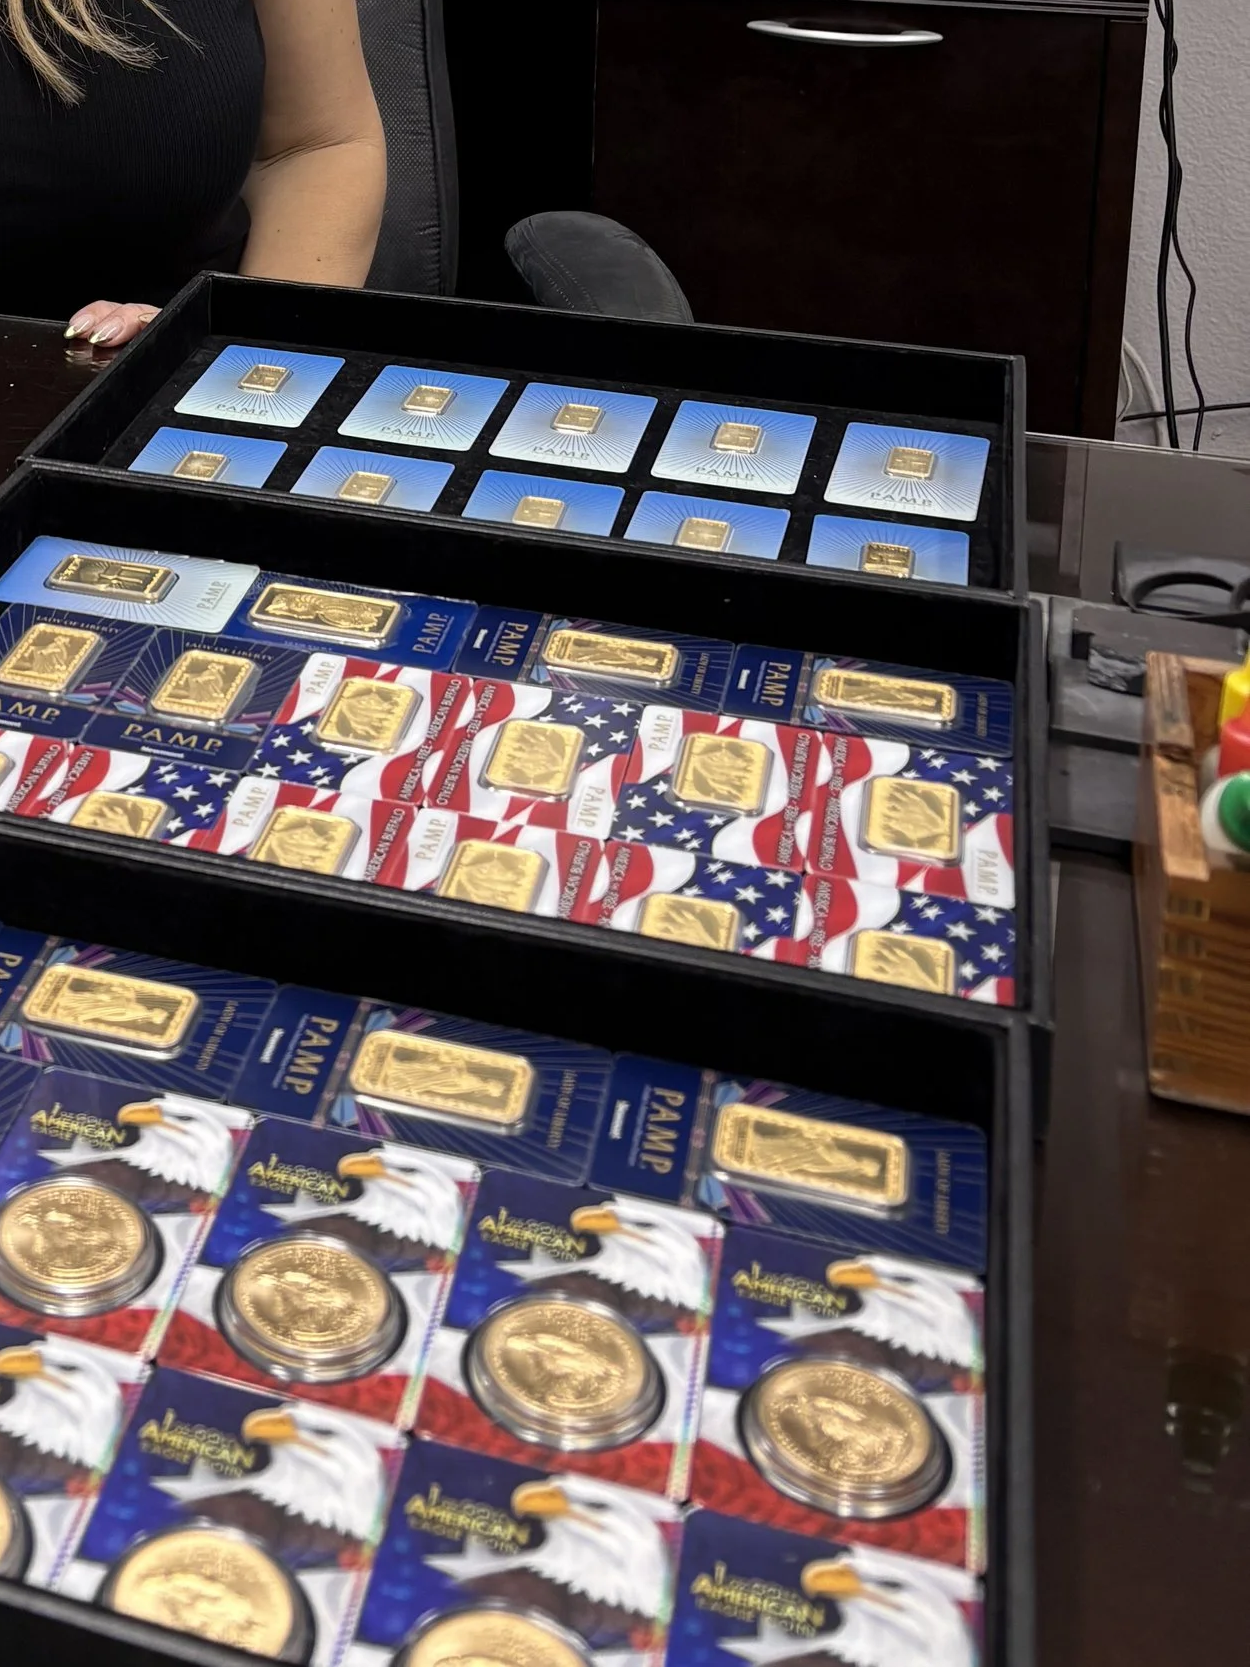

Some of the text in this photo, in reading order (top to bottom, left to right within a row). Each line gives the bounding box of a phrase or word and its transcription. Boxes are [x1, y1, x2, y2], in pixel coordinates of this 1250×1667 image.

[197, 580, 228, 611] PAMP
[413, 612, 449, 655] PAMP
[499, 620, 529, 668] PAMP
[306, 661, 338, 696] PAMP
[762, 661, 792, 708] PAMP
[474, 684, 497, 716] AMERICA
[123, 723, 223, 752] PAMP
[398, 678, 463, 802] AMERICA FREE AMERICAN BUFFALO
[648, 714, 675, 752] PAMP
[32, 744, 62, 781] BUFFALO
[66, 749, 96, 786] AMERICA
[449, 738, 475, 775] AMERICAN
[233, 787, 267, 827] PAMP
[436, 772, 459, 806] BUFFALO
[573, 784, 606, 830] PAMP
[778, 733, 812, 867] AMERICA FREE AMERICAN BUFFALO
[818, 736, 848, 872] AMERICA FREE AMERICAN BUFFALO
[381, 808, 406, 846] BUFFALO
[415, 818, 448, 861] PAMP
[573, 840, 592, 876] BUFFALO
[611, 845, 632, 883] AMERICA
[974, 847, 999, 900] PAMP
[814, 881, 832, 918] AMERICA
[284, 1015, 341, 1095] PAMP
[30, 1110, 127, 1144] AMERICAN
[639, 1086, 686, 1175] PAMP
[247, 1161, 349, 1198] AMERICAN
[478, 1215, 587, 1254] AMERICAN
[732, 1269, 848, 1311] AMERICAN
[138, 1418, 256, 1469] AMERICAN
[405, 1494, 530, 1545] AMERICAN
[691, 1572, 825, 1628] AMERICAN
